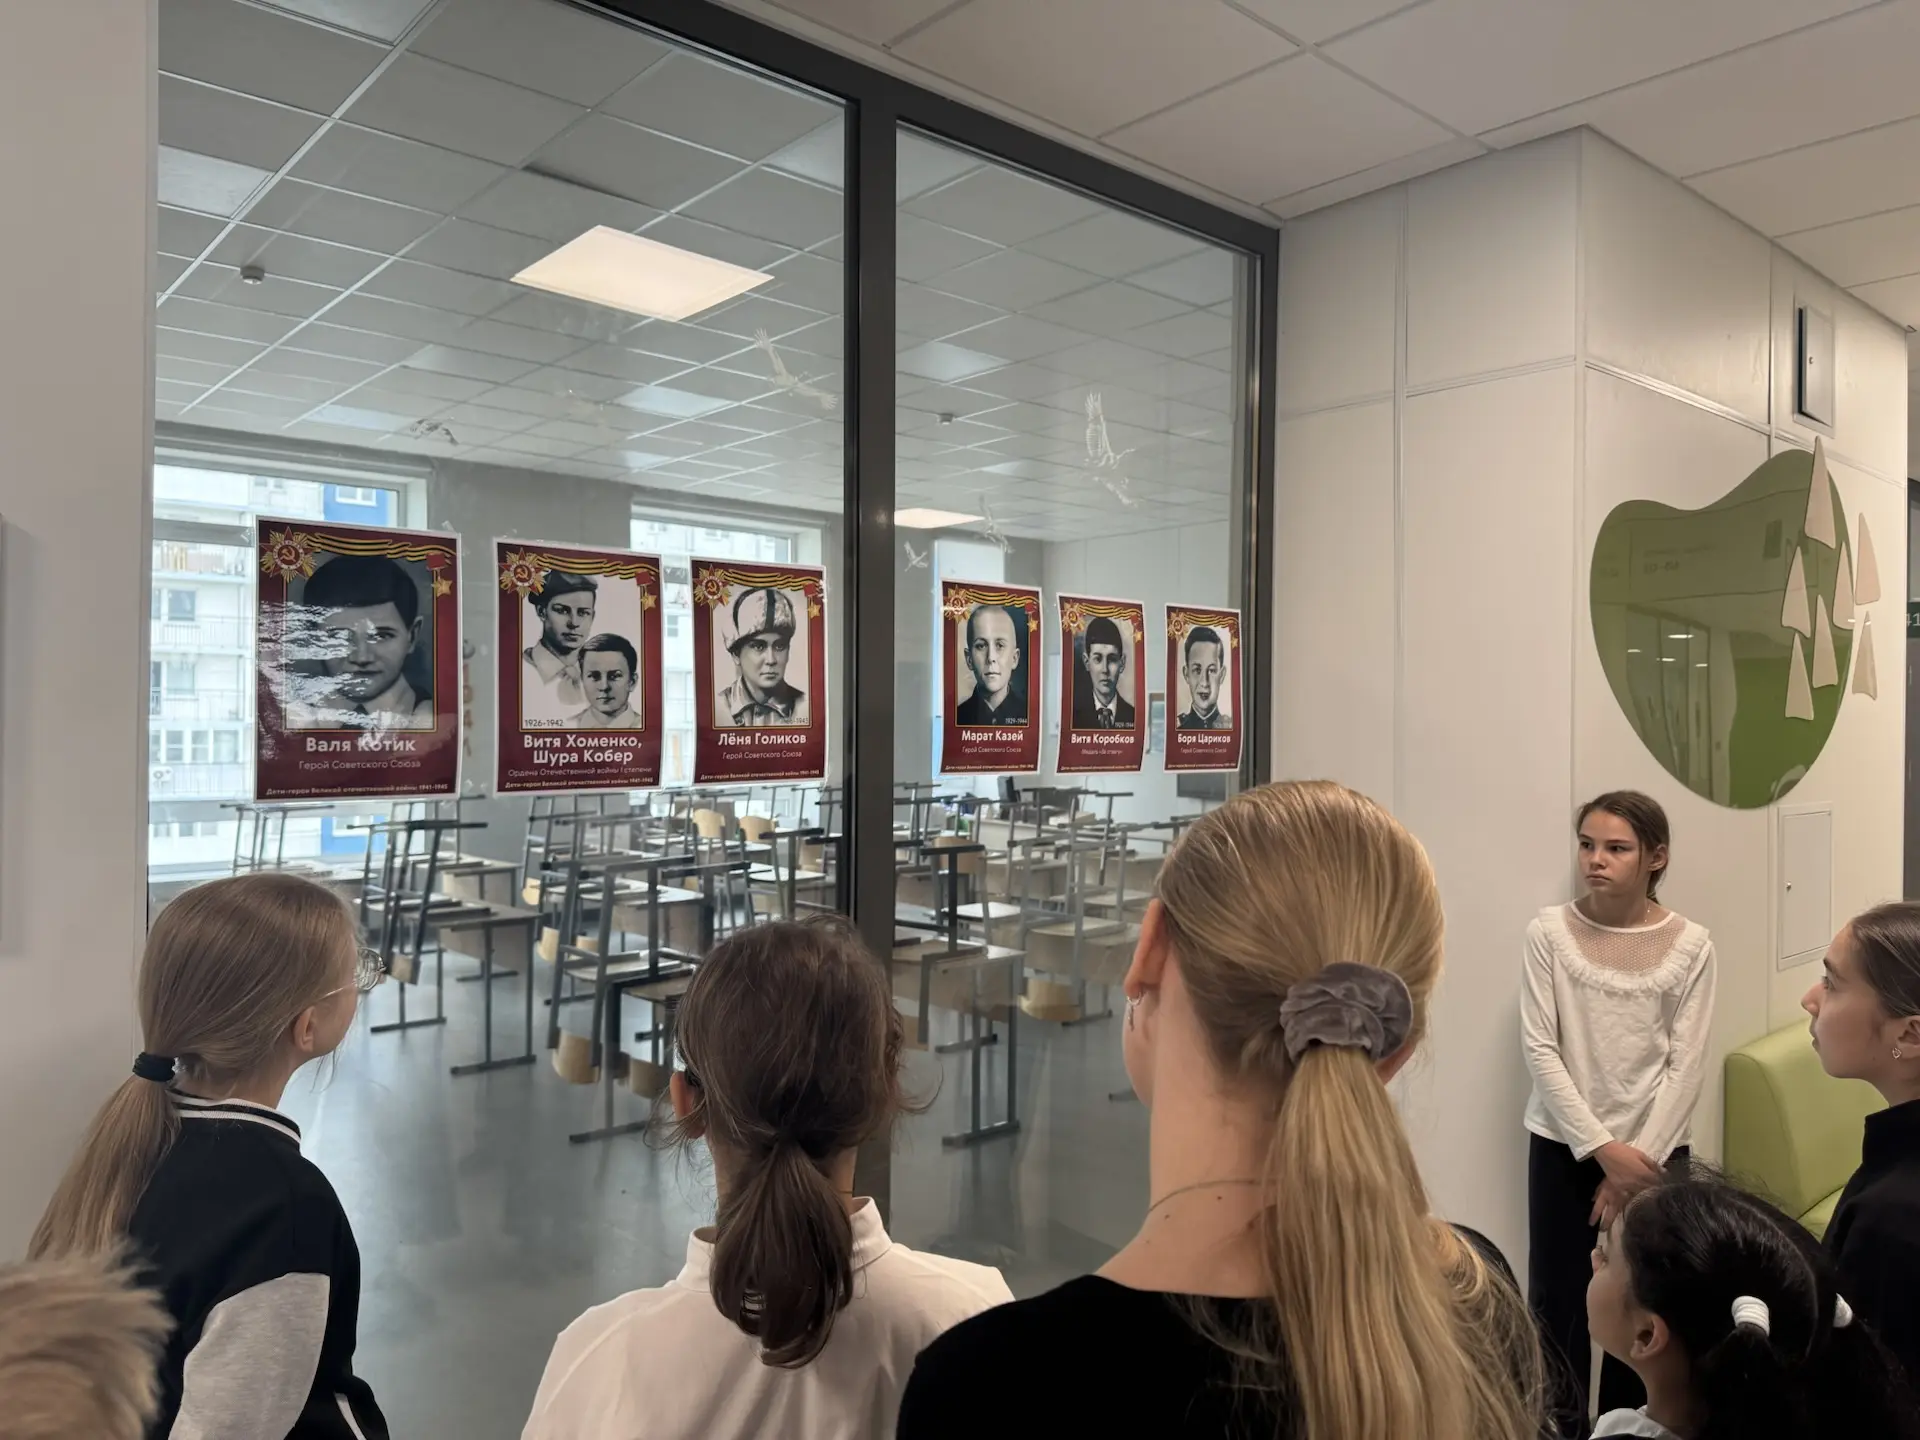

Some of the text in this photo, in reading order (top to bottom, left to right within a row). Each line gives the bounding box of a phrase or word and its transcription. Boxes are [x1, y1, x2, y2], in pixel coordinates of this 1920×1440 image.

[524, 719, 564, 727] 1926-1942
[523, 733, 643, 749] Витя Хоменко,
[718, 732, 807, 746] Лёня Голиков
[961, 729, 1024, 744] Марат Казей
[1071, 733, 1135, 746] Витя Коробков
[1177, 733, 1231, 746] Боря Цариков
[305, 735, 417, 752] Валя Котик
[533, 749, 634, 767] Шура Кобер
[722, 750, 803, 760] Герой Советского Союза
[299, 759, 422, 771] Герой Советского Союза
[507, 769, 539, 777] Ордена
[540, 767, 596, 776] Отечественной
[596, 766, 620, 774] войны
